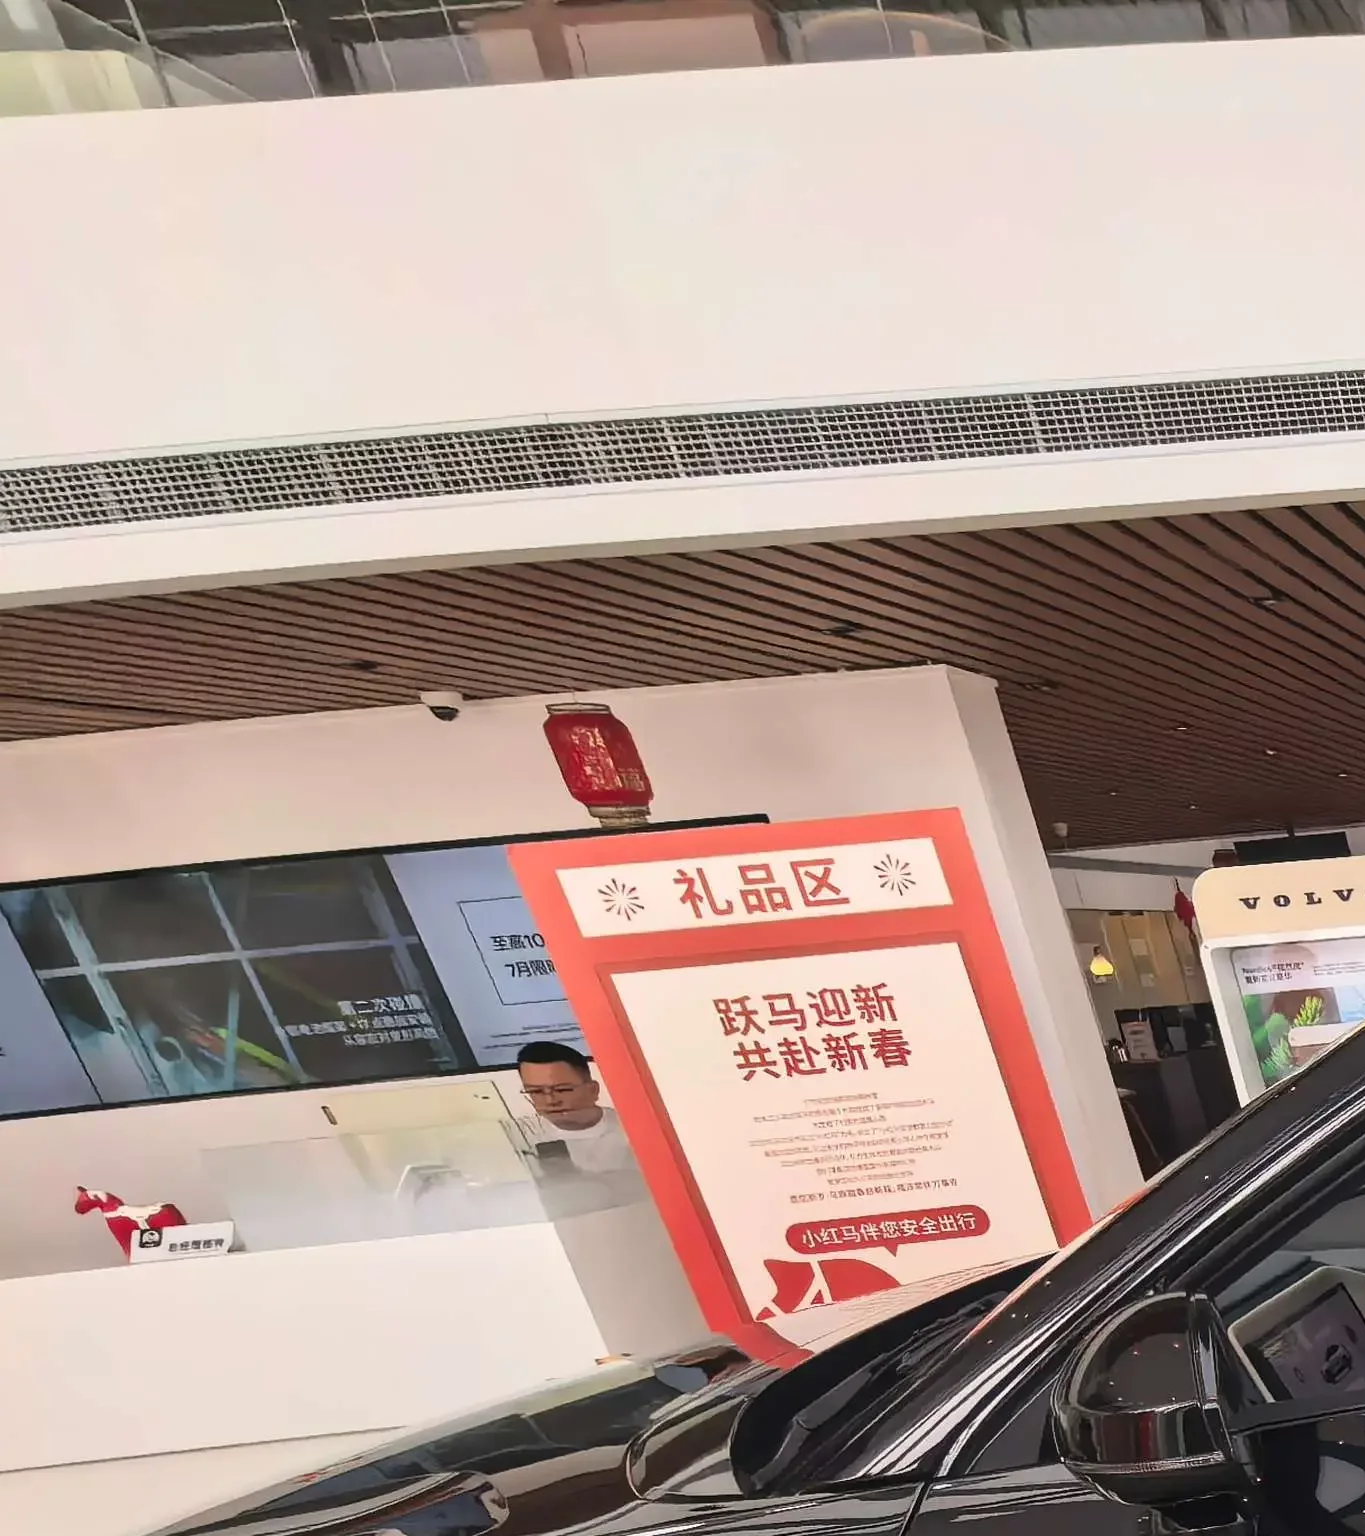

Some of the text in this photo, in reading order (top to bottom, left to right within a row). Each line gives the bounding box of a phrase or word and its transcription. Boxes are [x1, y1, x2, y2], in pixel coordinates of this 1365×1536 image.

[673, 858, 851, 919] 礼品区
[713, 982, 898, 1037] 跃马迎新
[733, 1028, 913, 1081] 共赴新春
[802, 1212, 976, 1249] 小红马伴您安全出行
